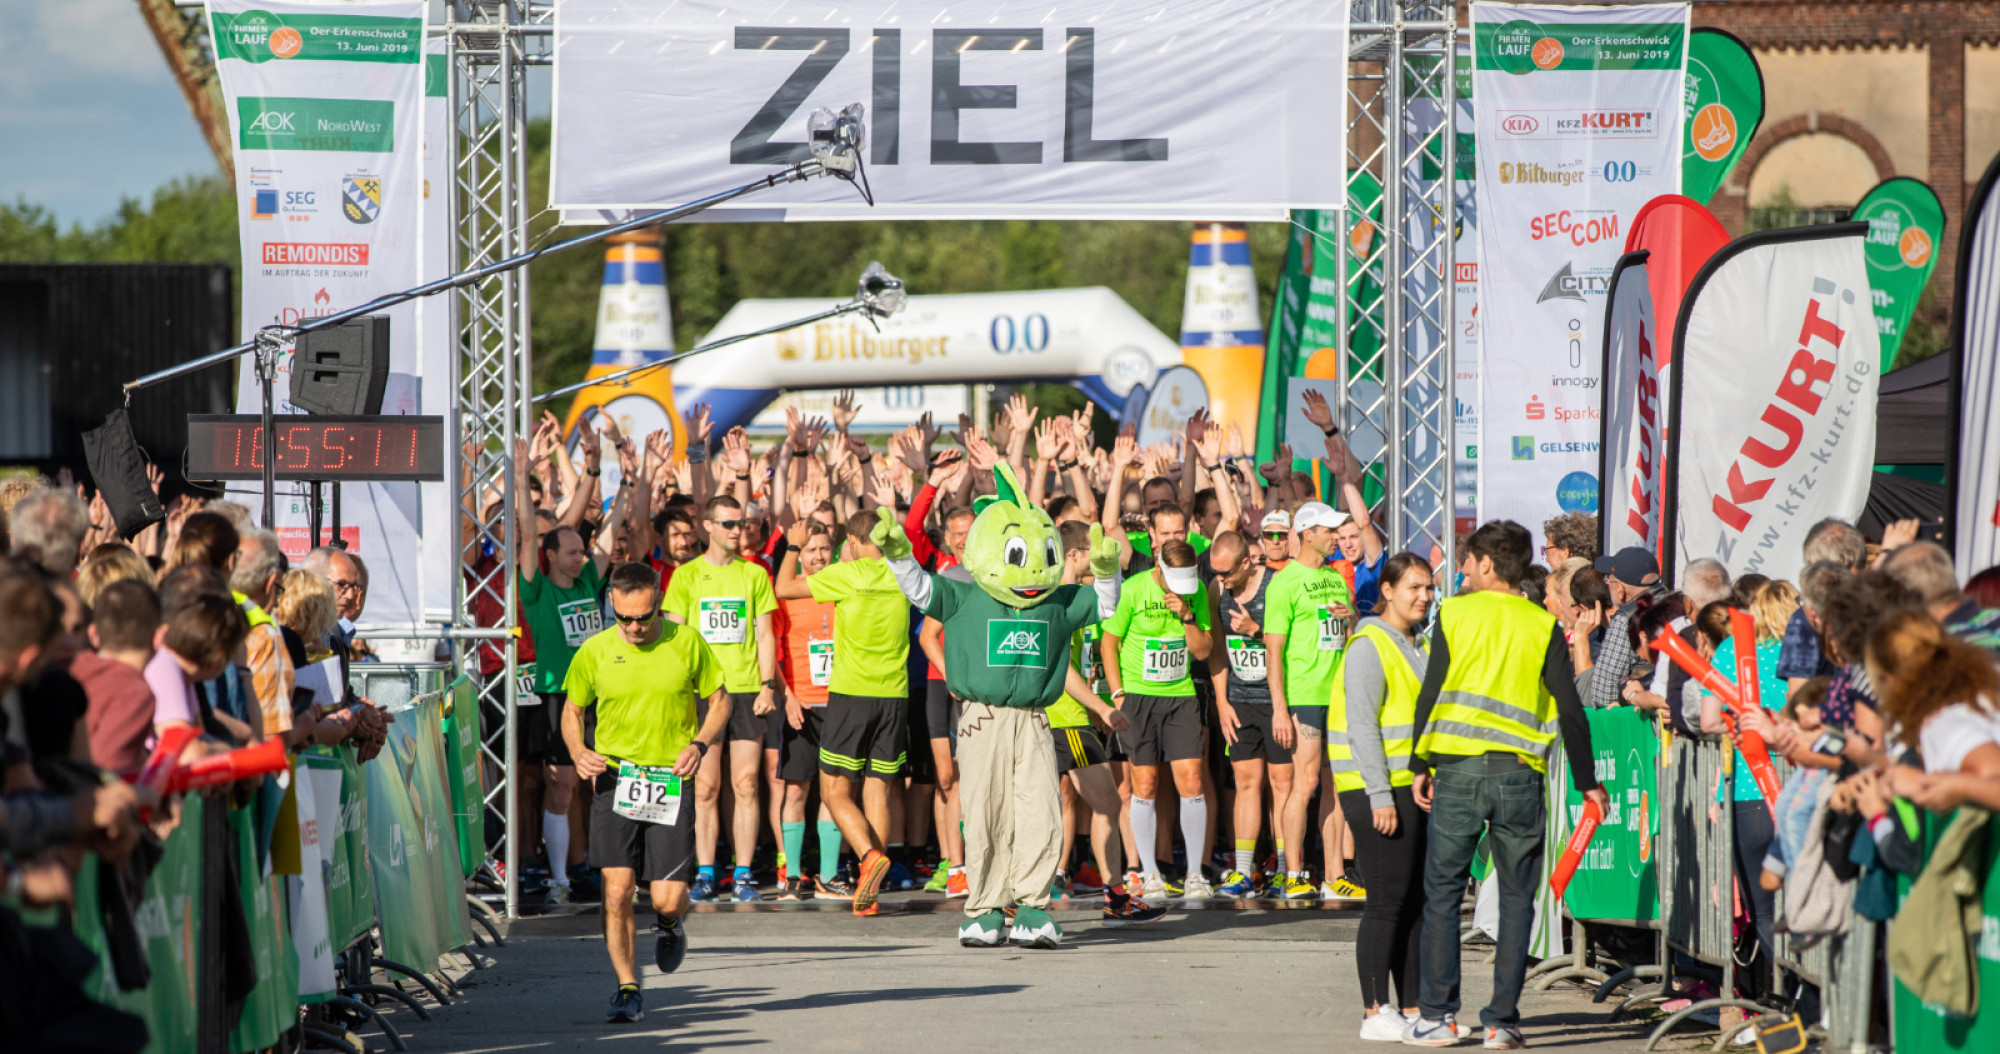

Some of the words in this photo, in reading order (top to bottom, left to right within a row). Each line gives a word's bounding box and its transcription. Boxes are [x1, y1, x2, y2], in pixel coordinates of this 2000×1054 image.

[234, 25, 268, 33] FIRMEN
[310, 26, 408, 39] Oer-Erkenschwick
[234, 34, 268, 45] LAUF
[1498, 36, 1530, 44] FIRMEN
[1572, 36, 1670, 46] Oer-Erkenschwick
[337, 41, 353, 51] 13.
[356, 42, 379, 52] Juni
[382, 43, 408, 53] 2019
[1498, 45, 1530, 56] LAUF
[1599, 51, 1614, 60] 13.
[1617, 50, 1639, 60] Juni
[1643, 50, 1670, 59] 2019
[729, 27, 1169, 166] ZIEL
[249, 111, 295, 130] AOK
[1508, 119, 1533, 131] KIA
[1515, 162, 1584, 187] Bitburger
[1603, 160, 1636, 183] 0.0
[286, 191, 315, 204] SEG
[265, 245, 360, 263] REMONDIS
[262, 269, 272, 277] IM
[275, 269, 311, 277] AUFTRAG
[332, 270, 369, 278] ZUKUNFT
[1561, 276, 1611, 290] CITY
[813, 322, 949, 364] Bitburger
[991, 313, 1050, 355] 0.0
[1552, 375, 1599, 389] innogy
[566, 612, 600, 633] 1015
[709, 611, 739, 629] 609
[998, 631, 1040, 650] AOK
[1149, 650, 1185, 668] 1005
[1231, 650, 1266, 668] 1261
[629, 781, 667, 806] 612
